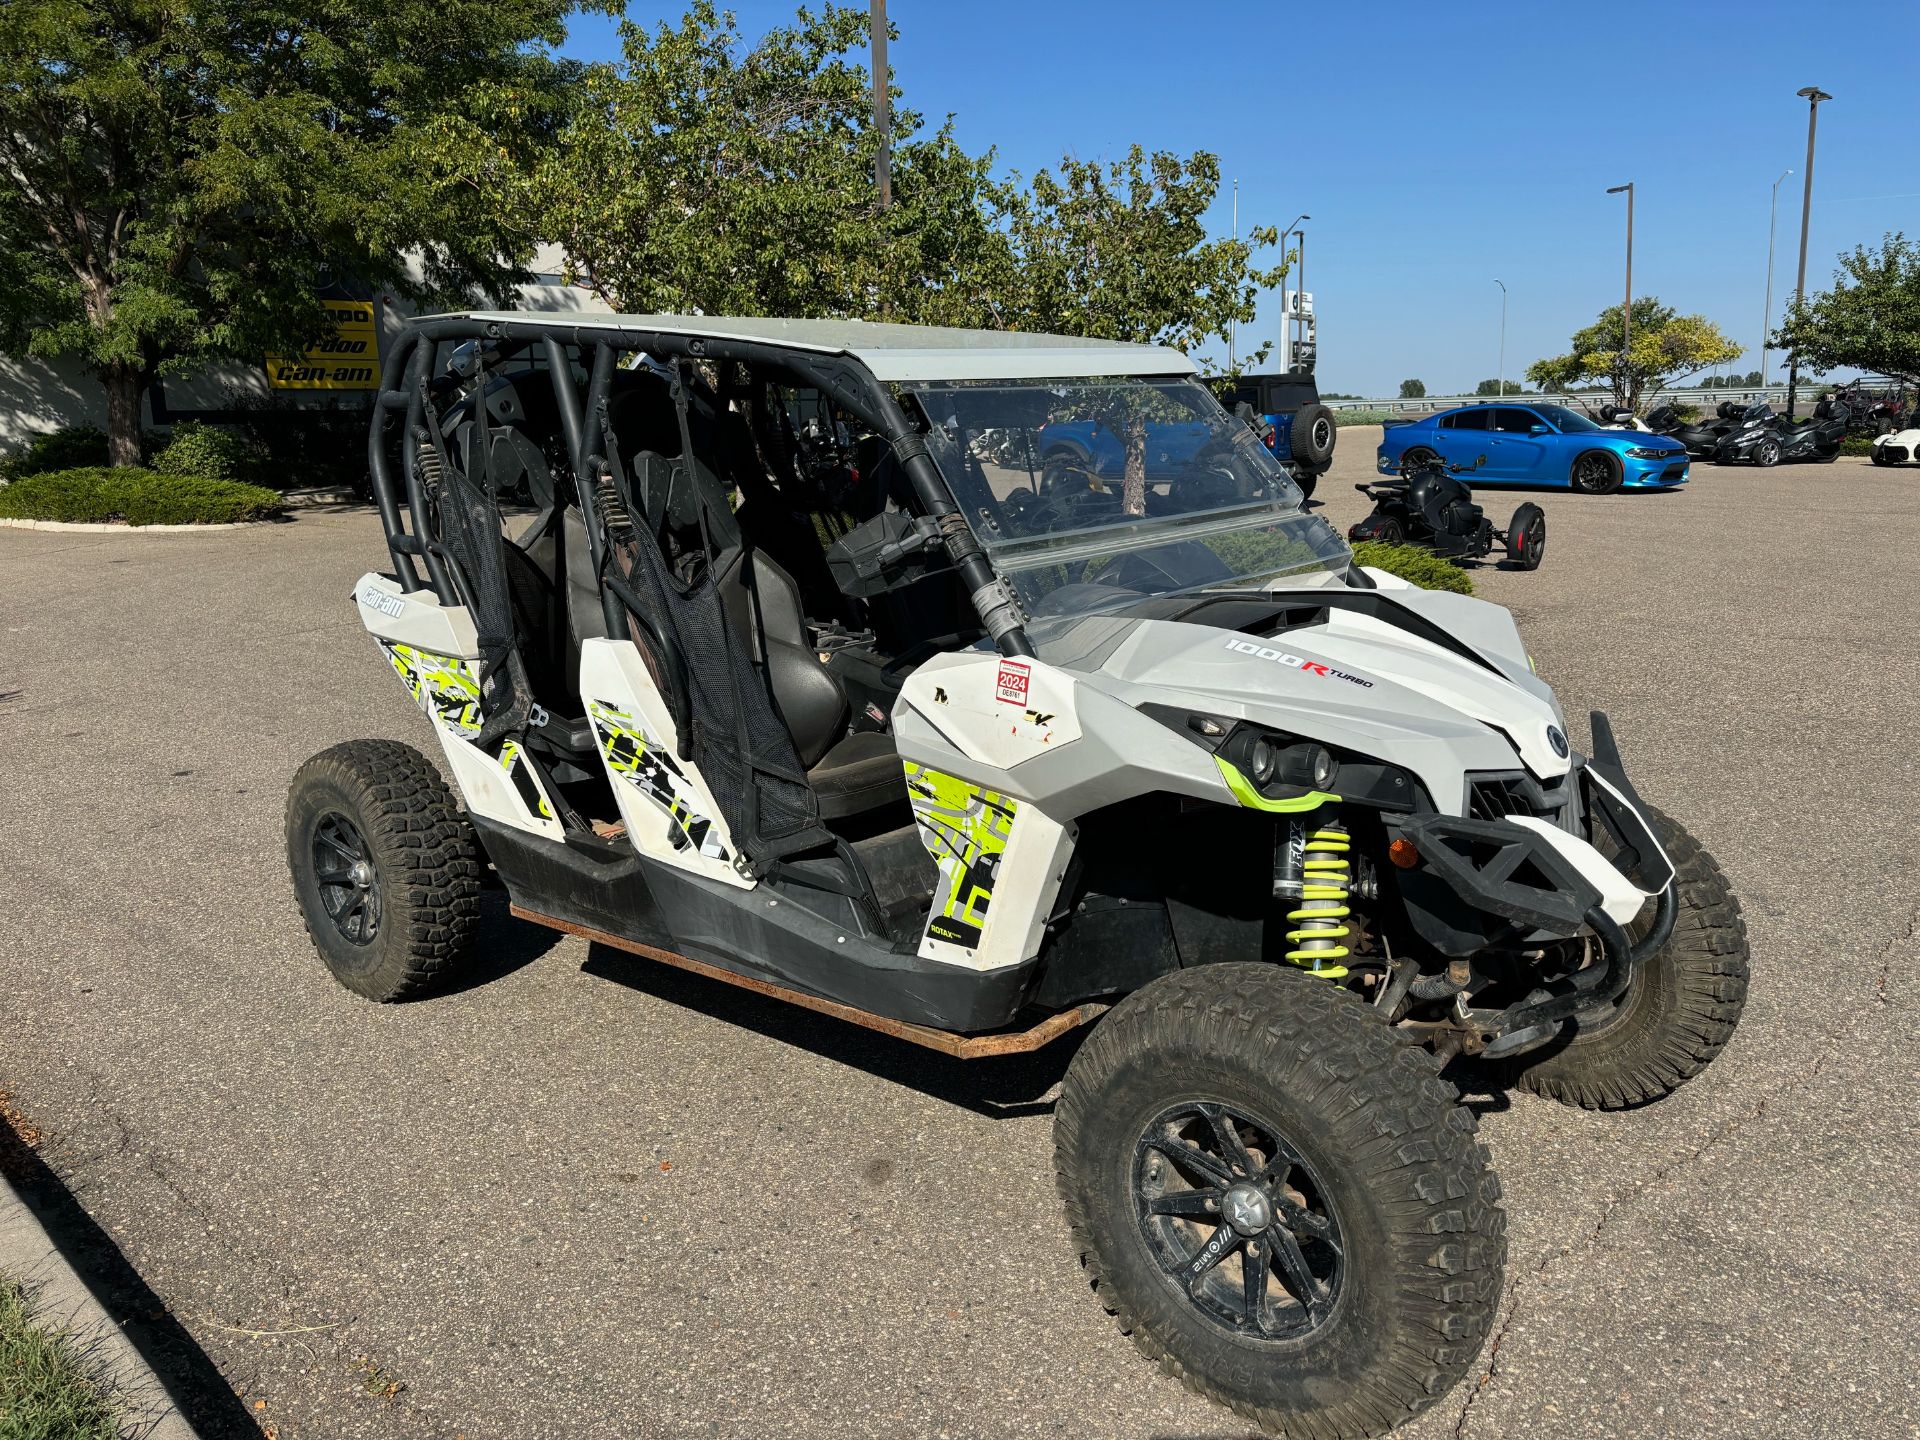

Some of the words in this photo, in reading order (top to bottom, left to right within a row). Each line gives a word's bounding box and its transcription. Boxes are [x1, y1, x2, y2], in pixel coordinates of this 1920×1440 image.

[1000, 673, 1026, 691] 2024
[1330, 669, 1374, 688] TURBO
[1289, 818, 1306, 868] FOX
[930, 925, 953, 938] ROTAX
